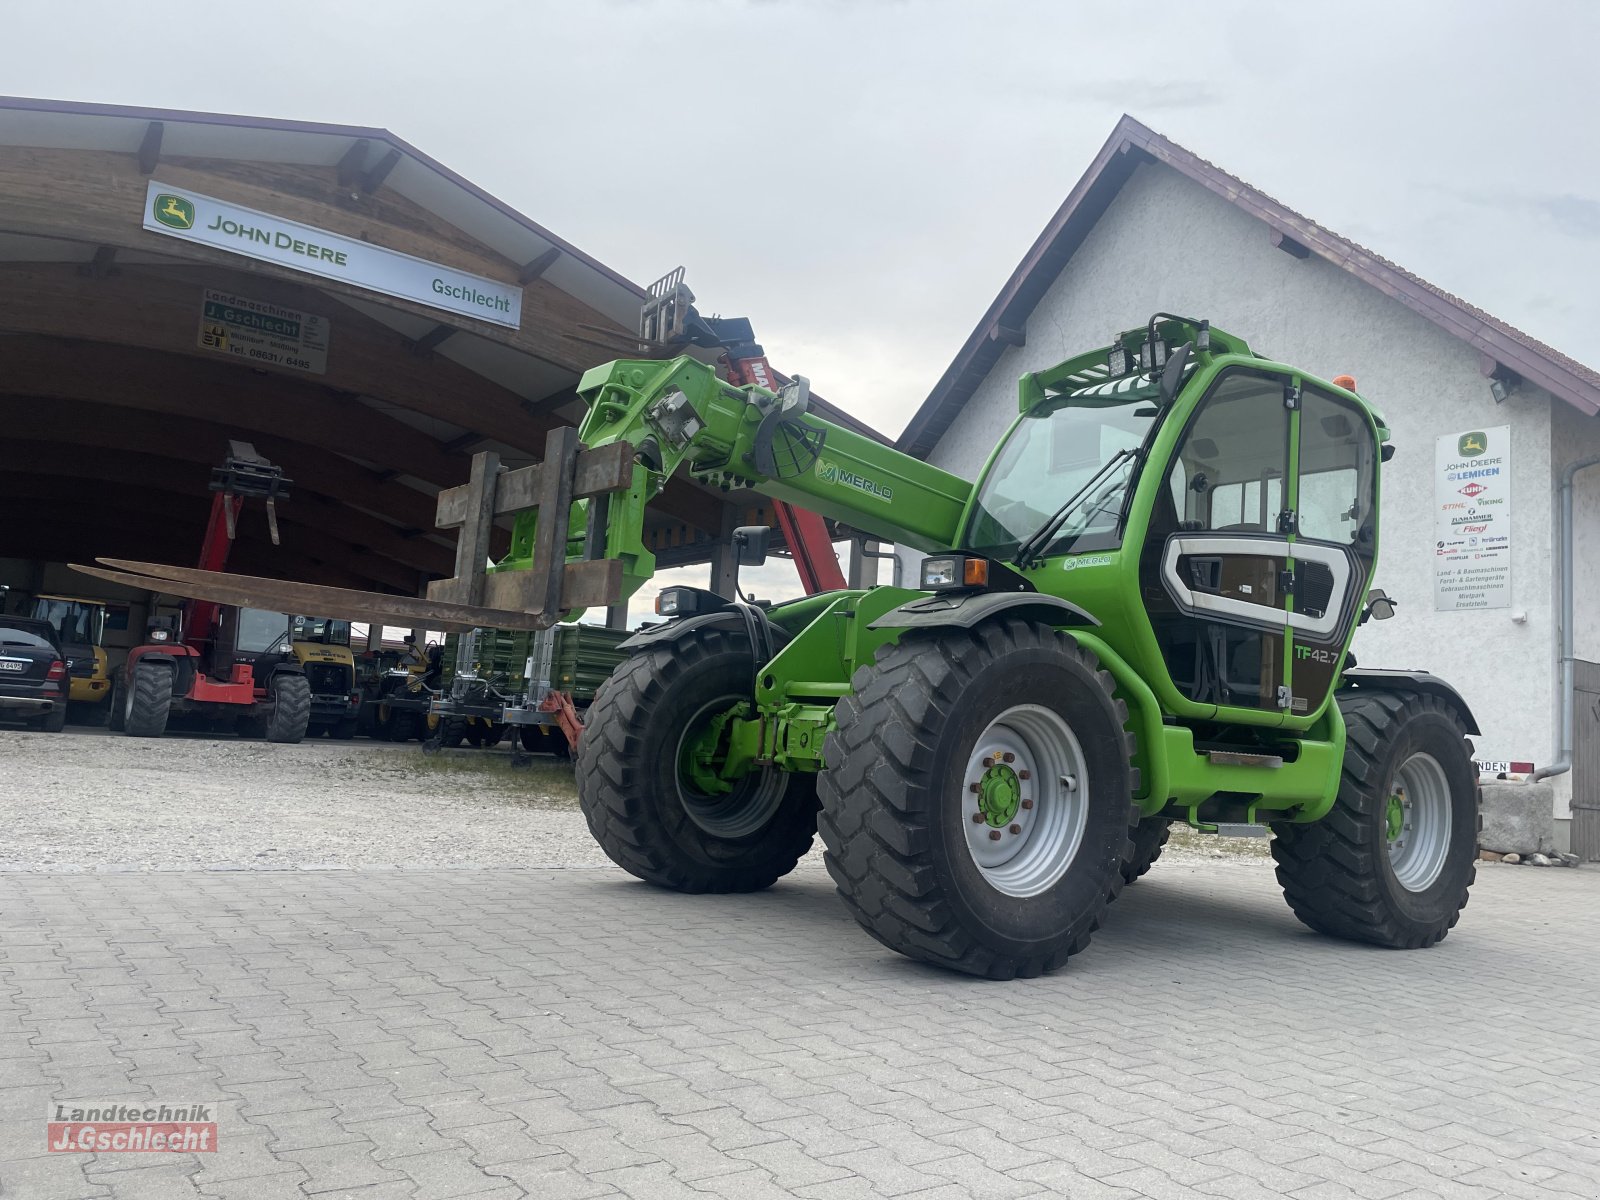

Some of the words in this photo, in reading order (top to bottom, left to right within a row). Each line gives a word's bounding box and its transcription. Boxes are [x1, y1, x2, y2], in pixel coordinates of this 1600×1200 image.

[207, 214, 271, 246] JOHN
[274, 230, 348, 267] DEERE
[205, 289, 302, 320] Landmaschinen
[431, 277, 511, 313] Gschlecht
[224, 309, 298, 336] Gschlecht
[229, 343, 247, 356] Tel.
[286, 356, 311, 369] 6495
[751, 362, 771, 392] MA
[1443, 461, 1469, 472] JOHN
[1470, 457, 1502, 468] DEERE
[1457, 467, 1500, 480] LEMKEN
[839, 469, 893, 500] MERLO
[1441, 502, 1466, 511] STIHL
[1476, 498, 1504, 506] VIKING
[1463, 524, 1488, 533] Fliegl
[1477, 761, 1507, 771] NDEN
